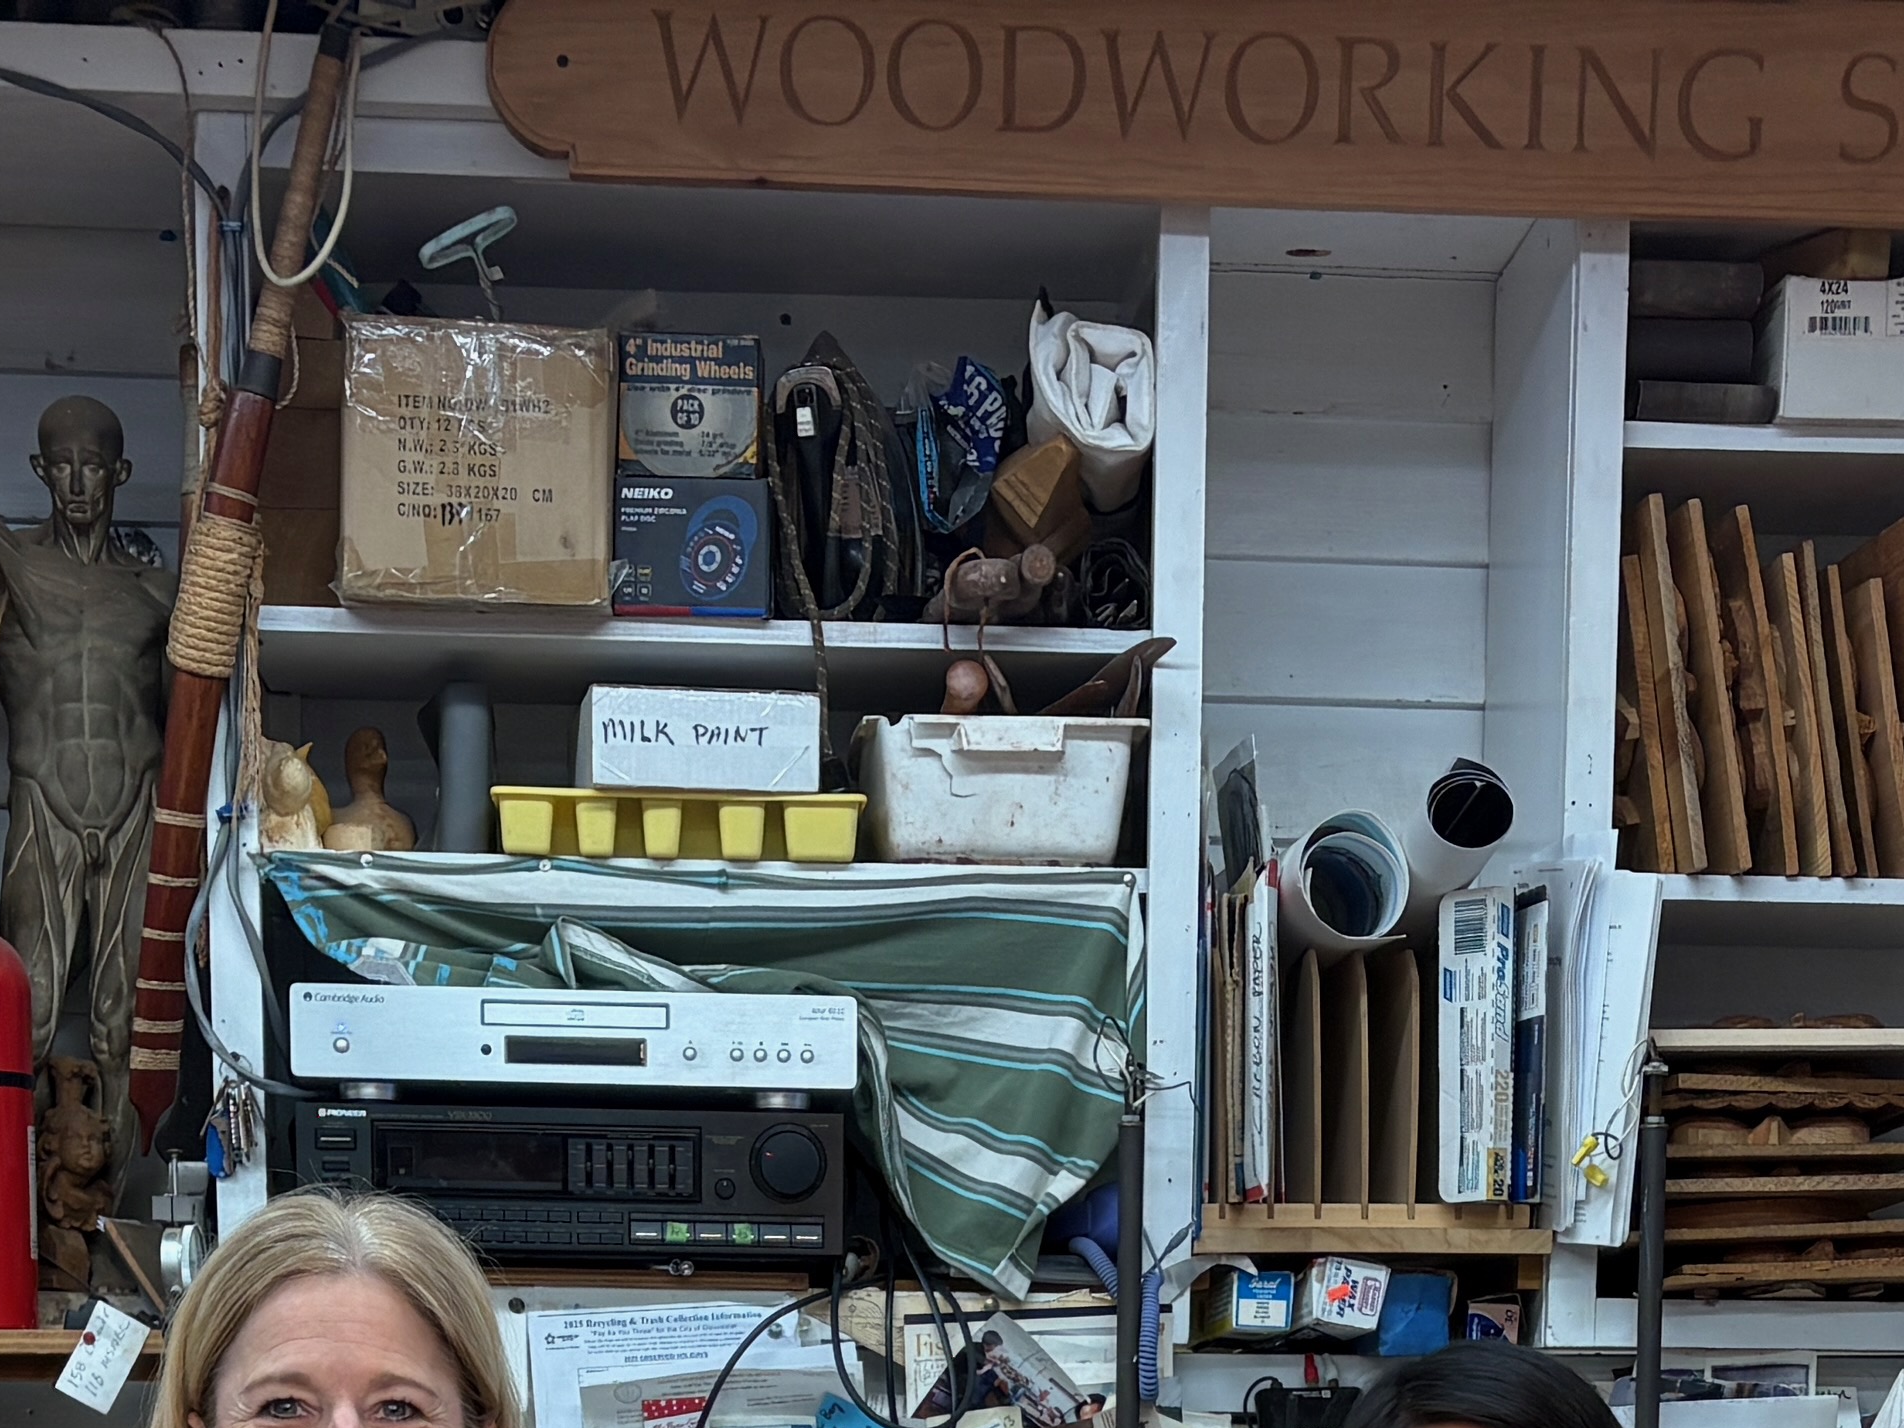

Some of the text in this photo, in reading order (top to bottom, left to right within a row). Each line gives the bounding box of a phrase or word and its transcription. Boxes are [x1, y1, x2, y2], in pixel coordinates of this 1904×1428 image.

[652, 8, 1765, 164] WOODWORKING
[1819, 280, 1849, 295] 4X24
[625, 337, 643, 355] 4"
[647, 337, 724, 358] Industrial
[625, 357, 754, 380] Grinding Wheels
[676, 398, 701, 412] PACK
[397, 416, 453, 432] QTY: 12
[676, 412, 700, 426] OF 10
[467, 440, 498, 457] KGS
[397, 459, 434, 475] G.W.:
[467, 462, 498, 478] KGS
[397, 482, 553, 504] SIZE: 38X20X20 CM
[620, 487, 674, 500] NEIKO
[397, 502, 438, 519] C/NO:
[601, 717, 769, 747] MILK PAINT
[313, 992, 386, 1005] Cambridge Audio
[1495, 940, 1511, 1044] ProSand
[1494, 1068, 1510, 1104] 220
[326, 1108, 368, 1118] PIONEER
[1336, 1265, 1353, 1319] PAER
[1347, 1279, 1360, 1313] WAX
[585, 1311, 762, 1330] Recycling & Trash Collection Information
